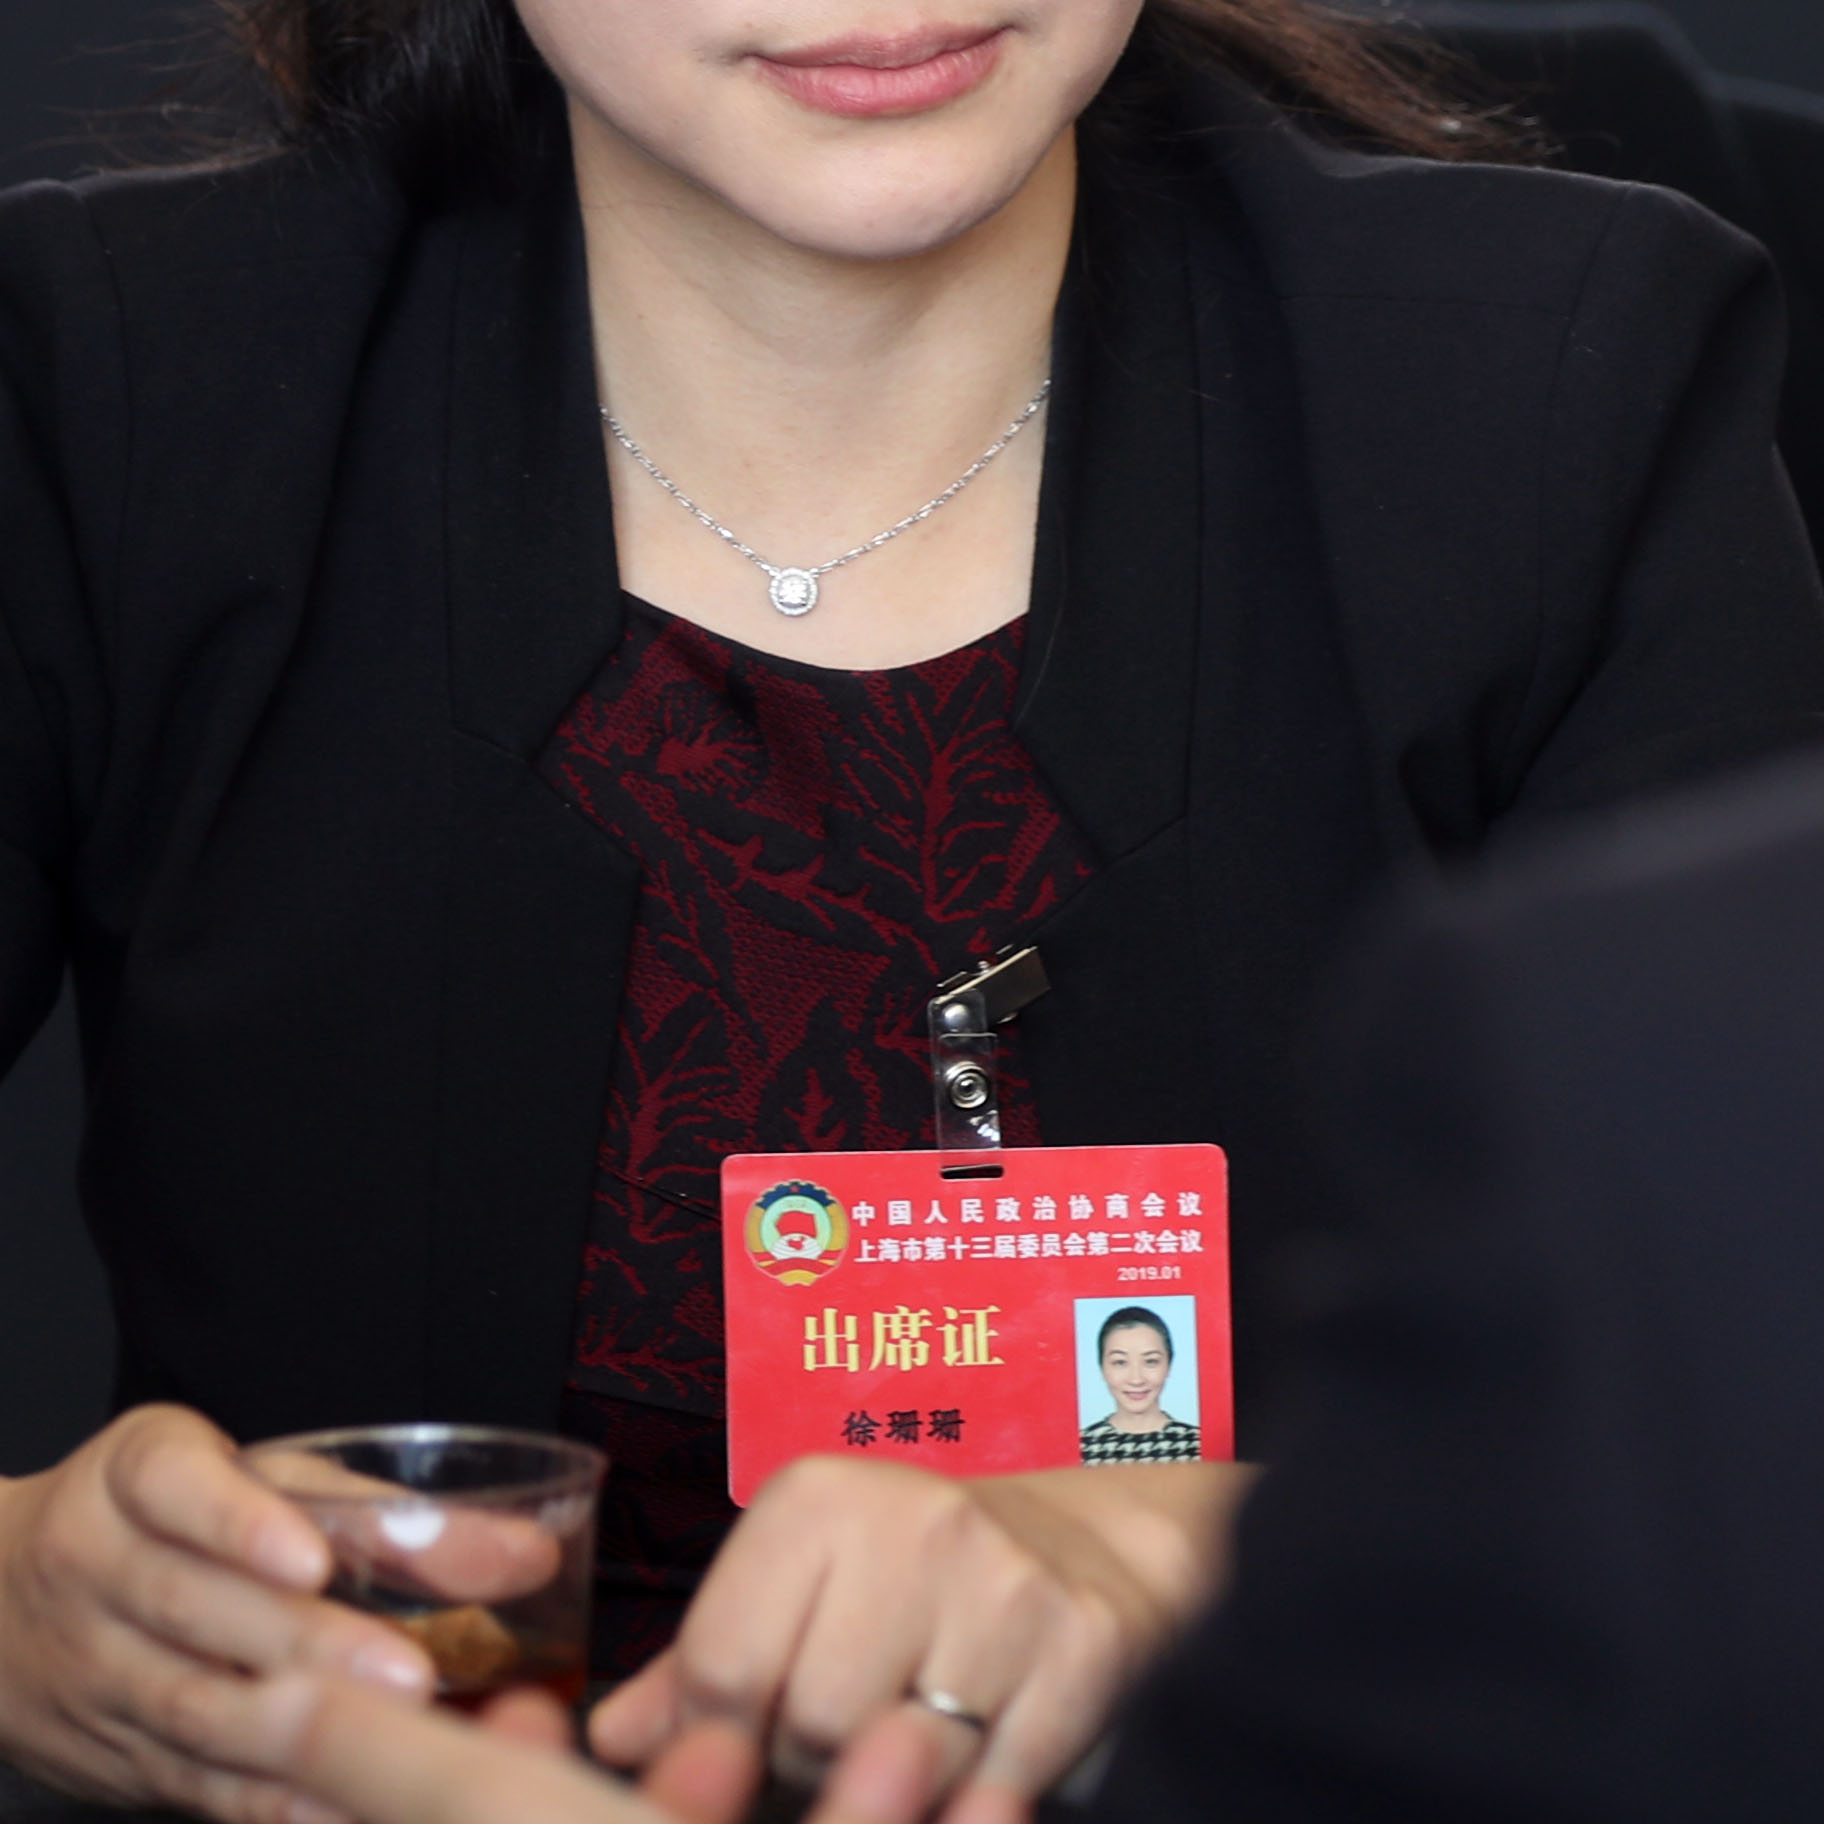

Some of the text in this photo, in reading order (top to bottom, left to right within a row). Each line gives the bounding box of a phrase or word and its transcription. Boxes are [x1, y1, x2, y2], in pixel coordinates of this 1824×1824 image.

[851, 1191, 1203, 1227] 中国人民政治协商会议
[853, 1229, 1204, 1263] 上海市第十三届委员会第二次会议
[1116, 1265, 1182, 1282] 2019.01
[803, 1305, 1005, 1373] 出席证
[840, 1408, 966, 1447] 徐珊珊
